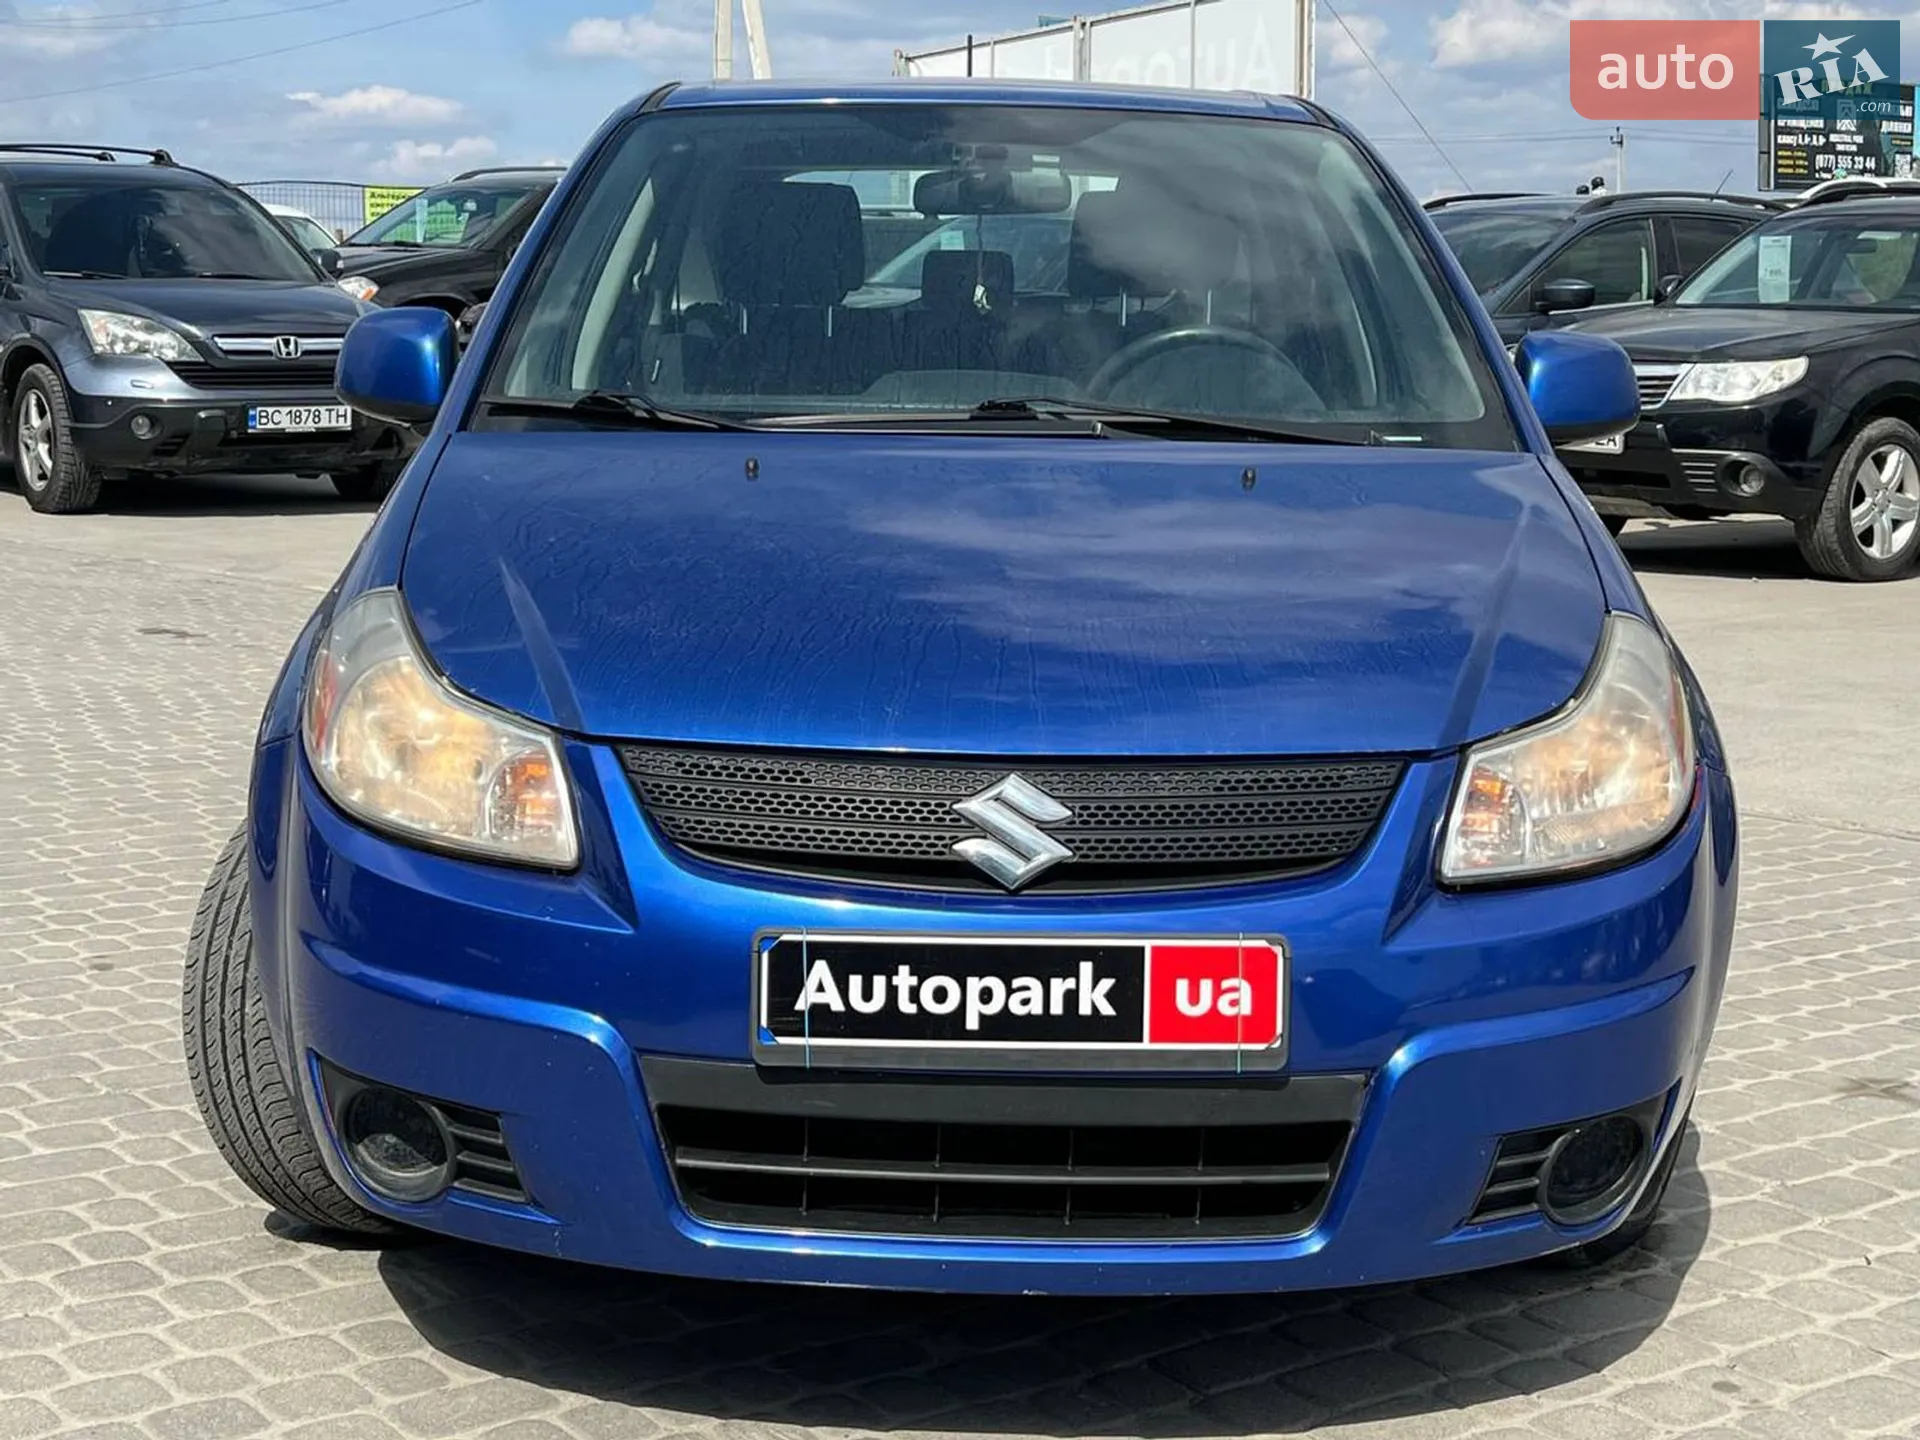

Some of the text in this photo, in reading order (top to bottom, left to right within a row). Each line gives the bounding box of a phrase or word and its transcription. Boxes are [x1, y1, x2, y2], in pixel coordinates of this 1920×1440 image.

[258, 408, 348, 426] BC 1878 TH
[793, 958, 1253, 1031] Autopark ua
